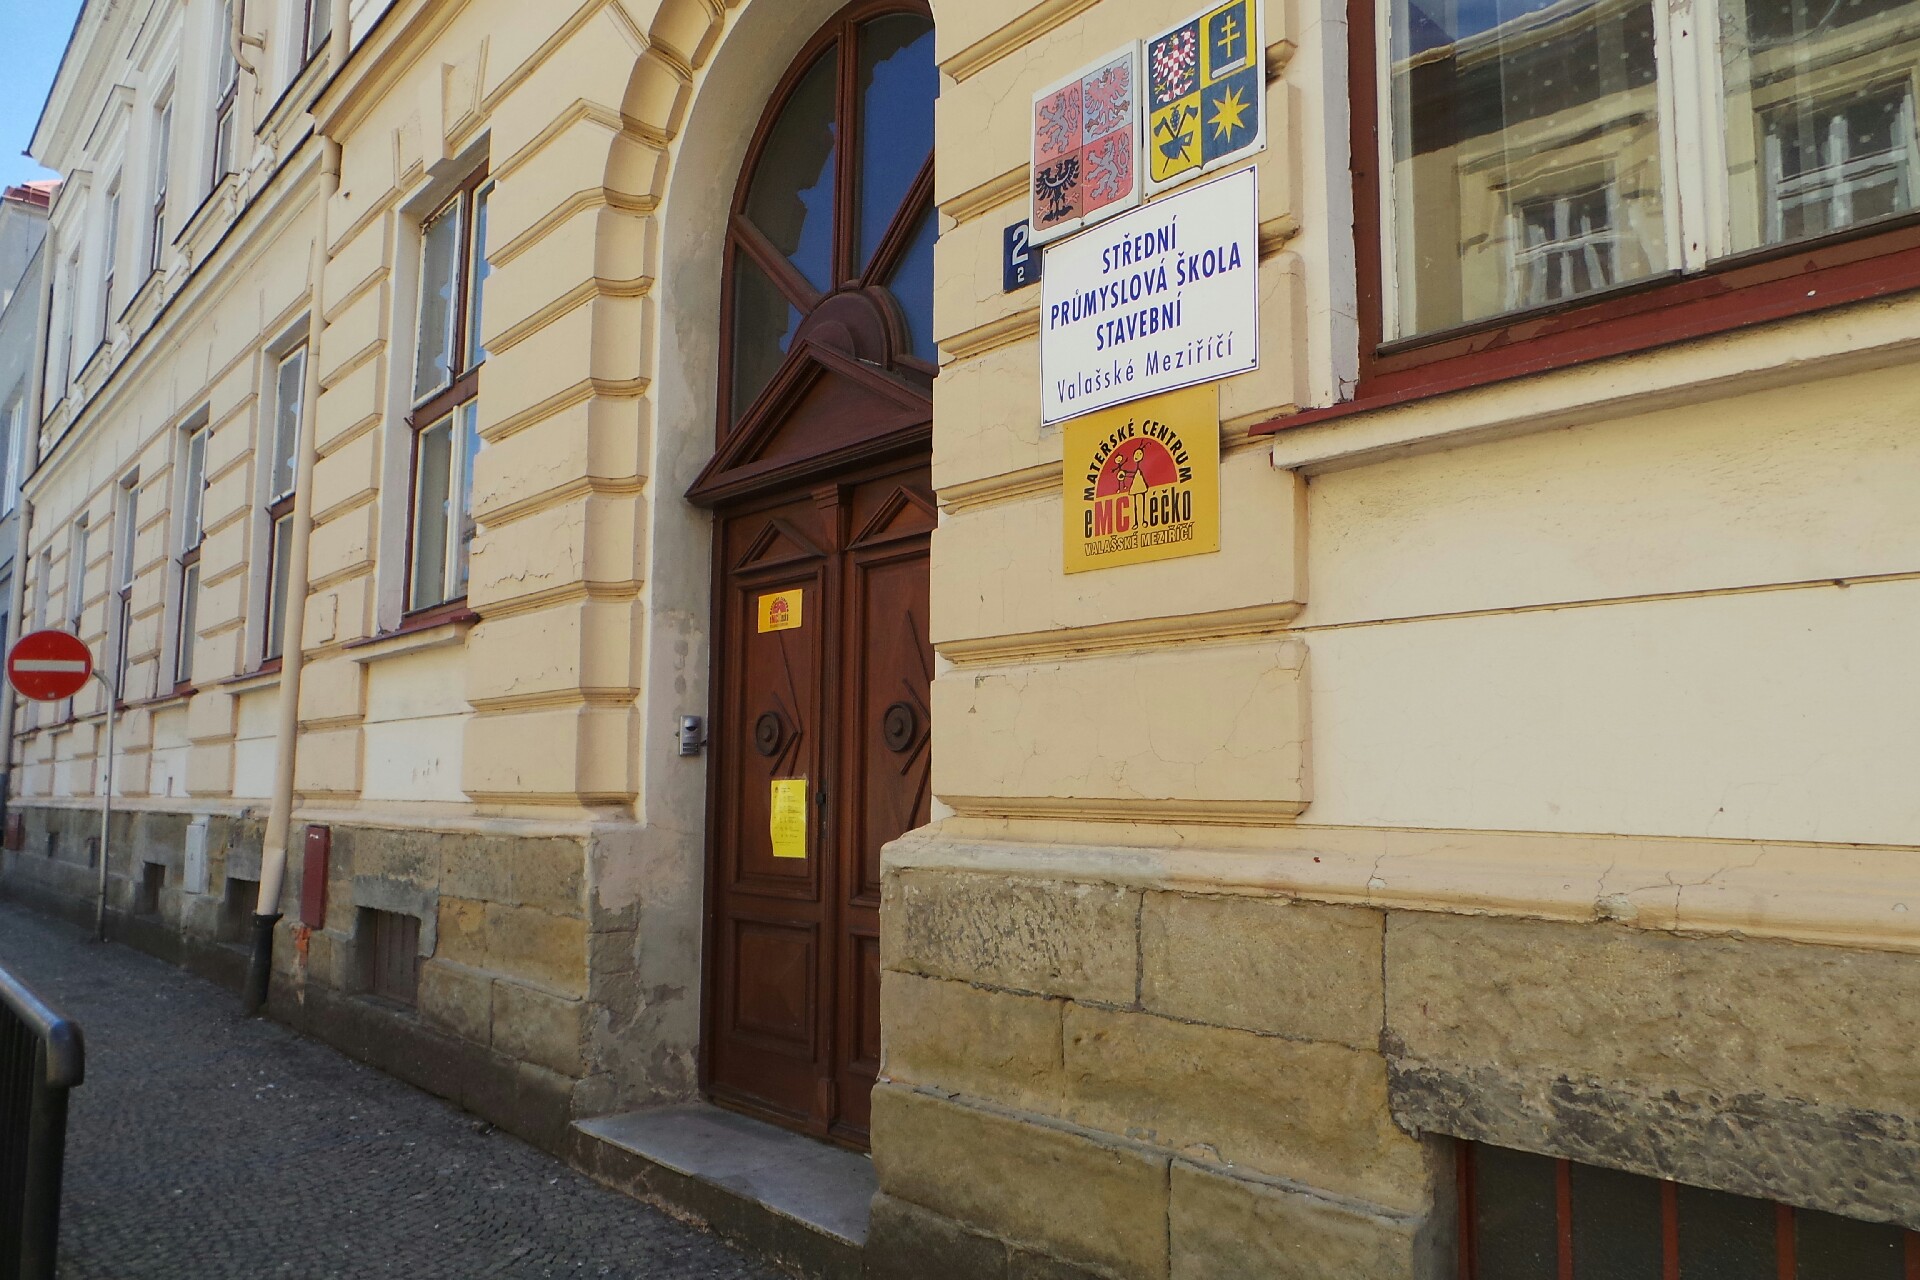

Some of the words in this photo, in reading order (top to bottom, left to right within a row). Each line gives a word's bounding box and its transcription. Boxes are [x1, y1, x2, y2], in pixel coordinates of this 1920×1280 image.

[1012, 224, 1029, 266] 2
[1102, 214, 1177, 274] STŘEDNÍ
[1017, 266, 1025, 283] 2
[1050, 258, 1168, 330] PRŮMYSLOVÁ
[1176, 242, 1242, 287] ŠKOLA
[1096, 291, 1182, 351] STAVEBNÍ
[1057, 359, 1134, 404] Valašské
[1145, 331, 1234, 377] Meziříčí
[1083, 418, 1135, 502] MATEŘSKÉ
[1142, 419, 1193, 484] CENTRUM
[1084, 531, 1139, 557] VALAŠSKÉ
[1141, 521, 1195, 547] MEZIŘÍČÍ
